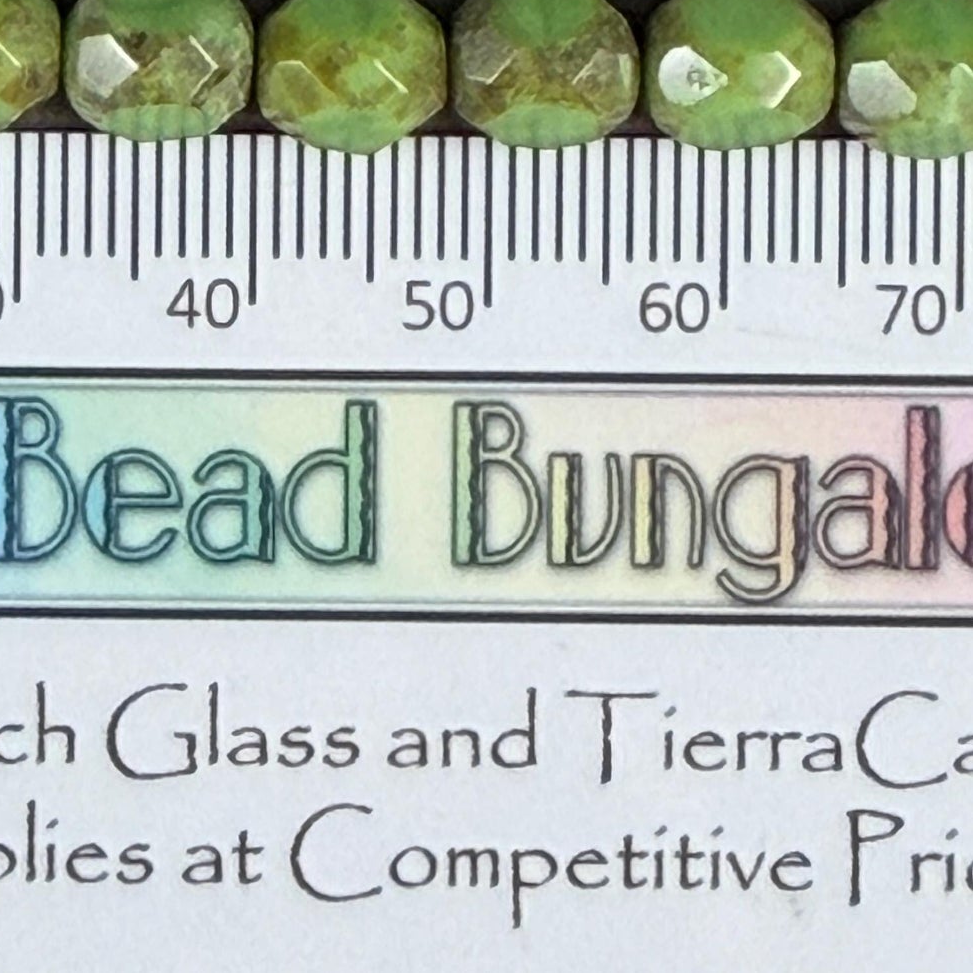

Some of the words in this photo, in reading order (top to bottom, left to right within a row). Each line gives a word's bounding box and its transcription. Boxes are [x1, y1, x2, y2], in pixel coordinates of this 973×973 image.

[166, 278, 240, 329] 40
[402, 280, 474, 332] 50
[639, 282, 710, 334] 60
[875, 284, 947, 336] 70
[105, 681, 360, 781] Glass
[386, 686, 538, 769] and
[181, 829, 265, 885] at
[289, 802, 813, 930] Competitive
[845, 808, 973, 907] Pri
